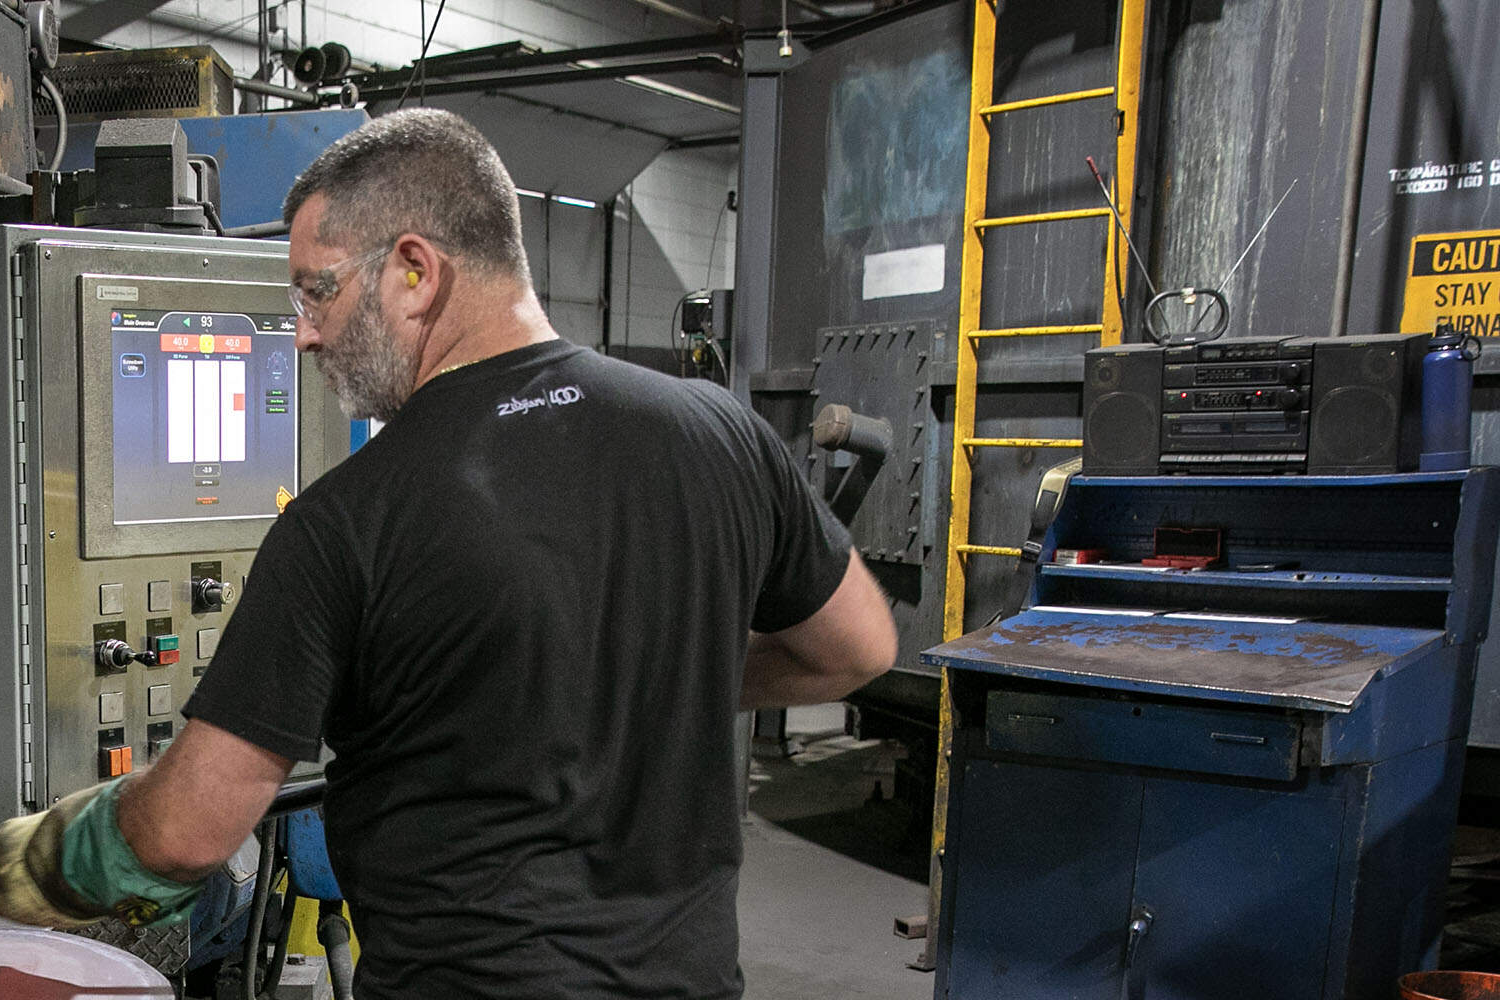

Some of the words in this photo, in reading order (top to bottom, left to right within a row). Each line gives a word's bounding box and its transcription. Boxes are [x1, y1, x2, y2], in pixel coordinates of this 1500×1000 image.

[1432, 240, 1500, 272] CAUT
[1435, 282, 1492, 307] STAY
[201, 316, 213, 327] 93
[173, 337, 188, 346] 40.0
[225, 339, 240, 347] 40.0
